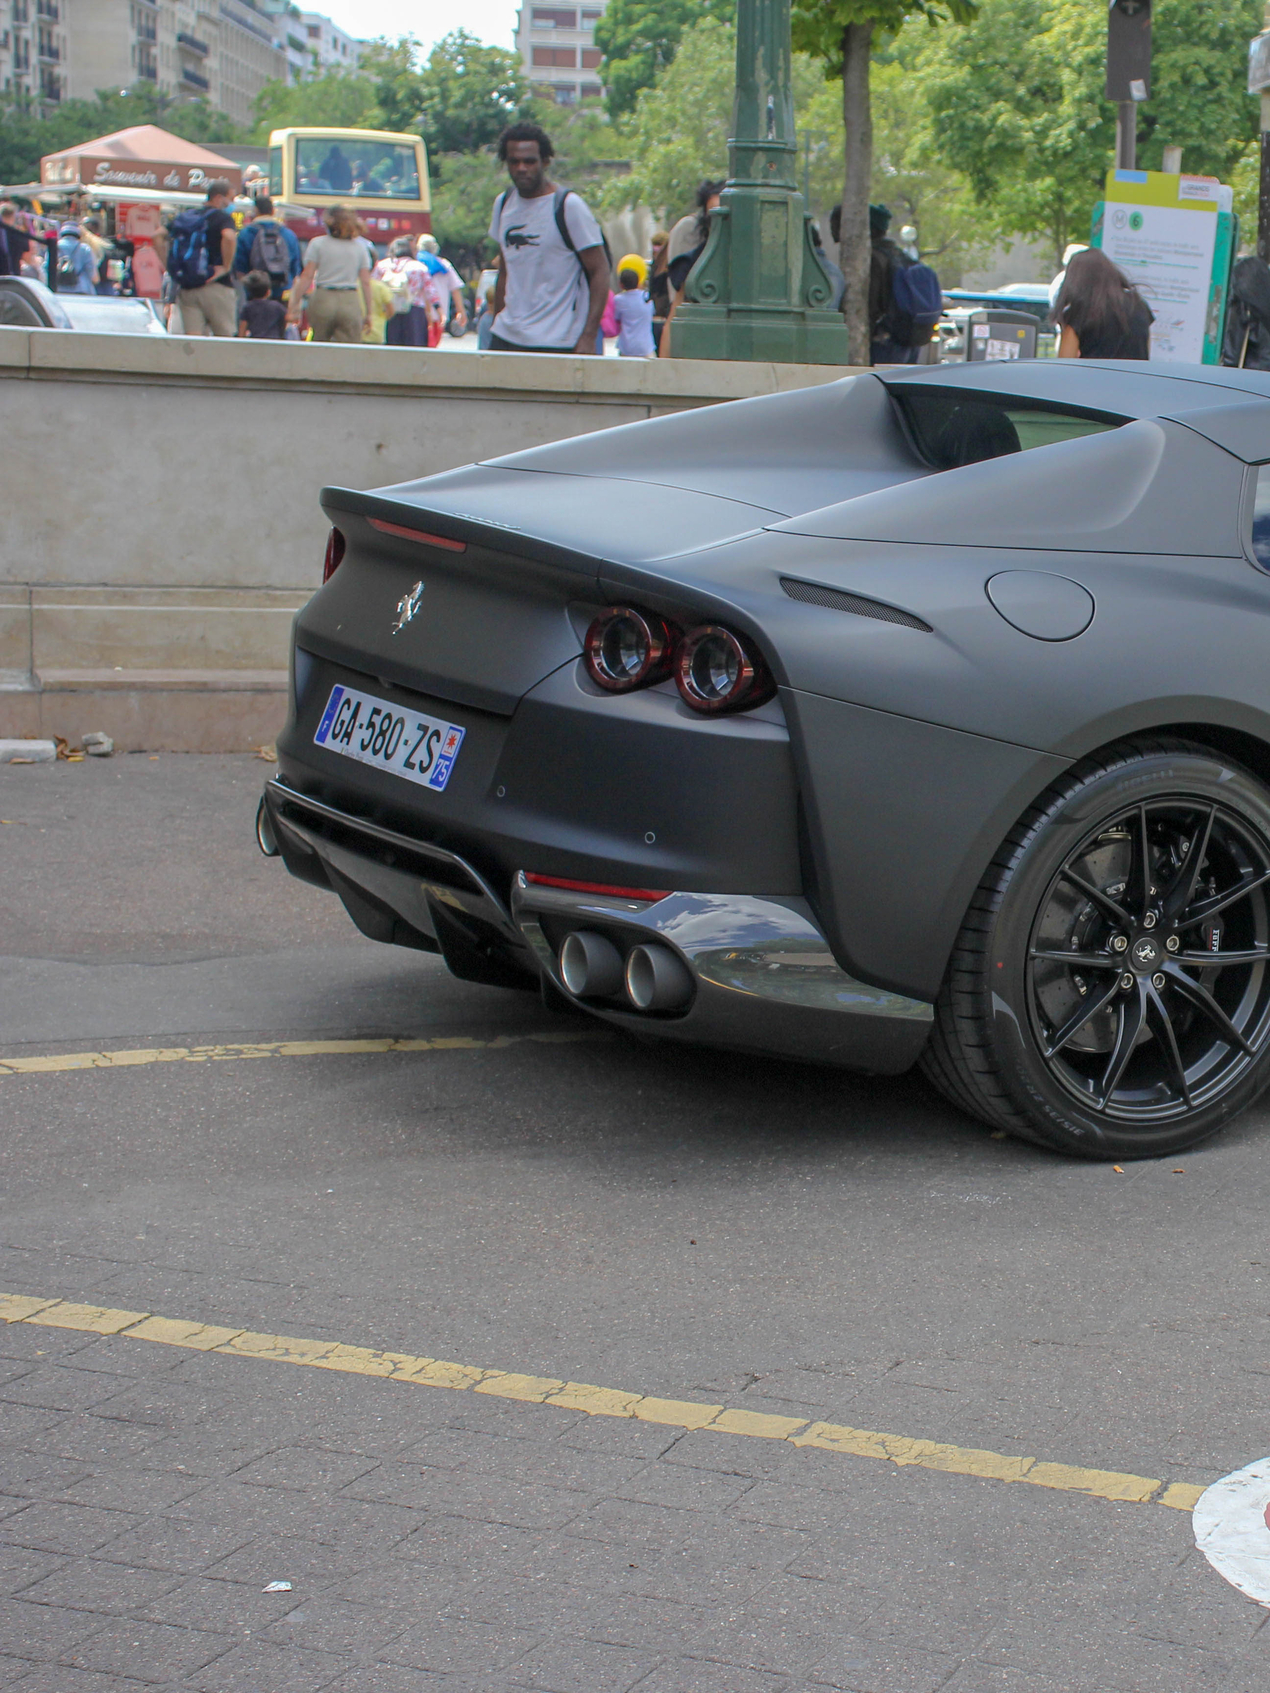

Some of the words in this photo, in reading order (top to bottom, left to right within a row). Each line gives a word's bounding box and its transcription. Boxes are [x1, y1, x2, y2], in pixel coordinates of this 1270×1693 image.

[163, 169, 181, 188] de
[331, 698, 441, 774] GA-580-ZS
[432, 759, 450, 781] 75
